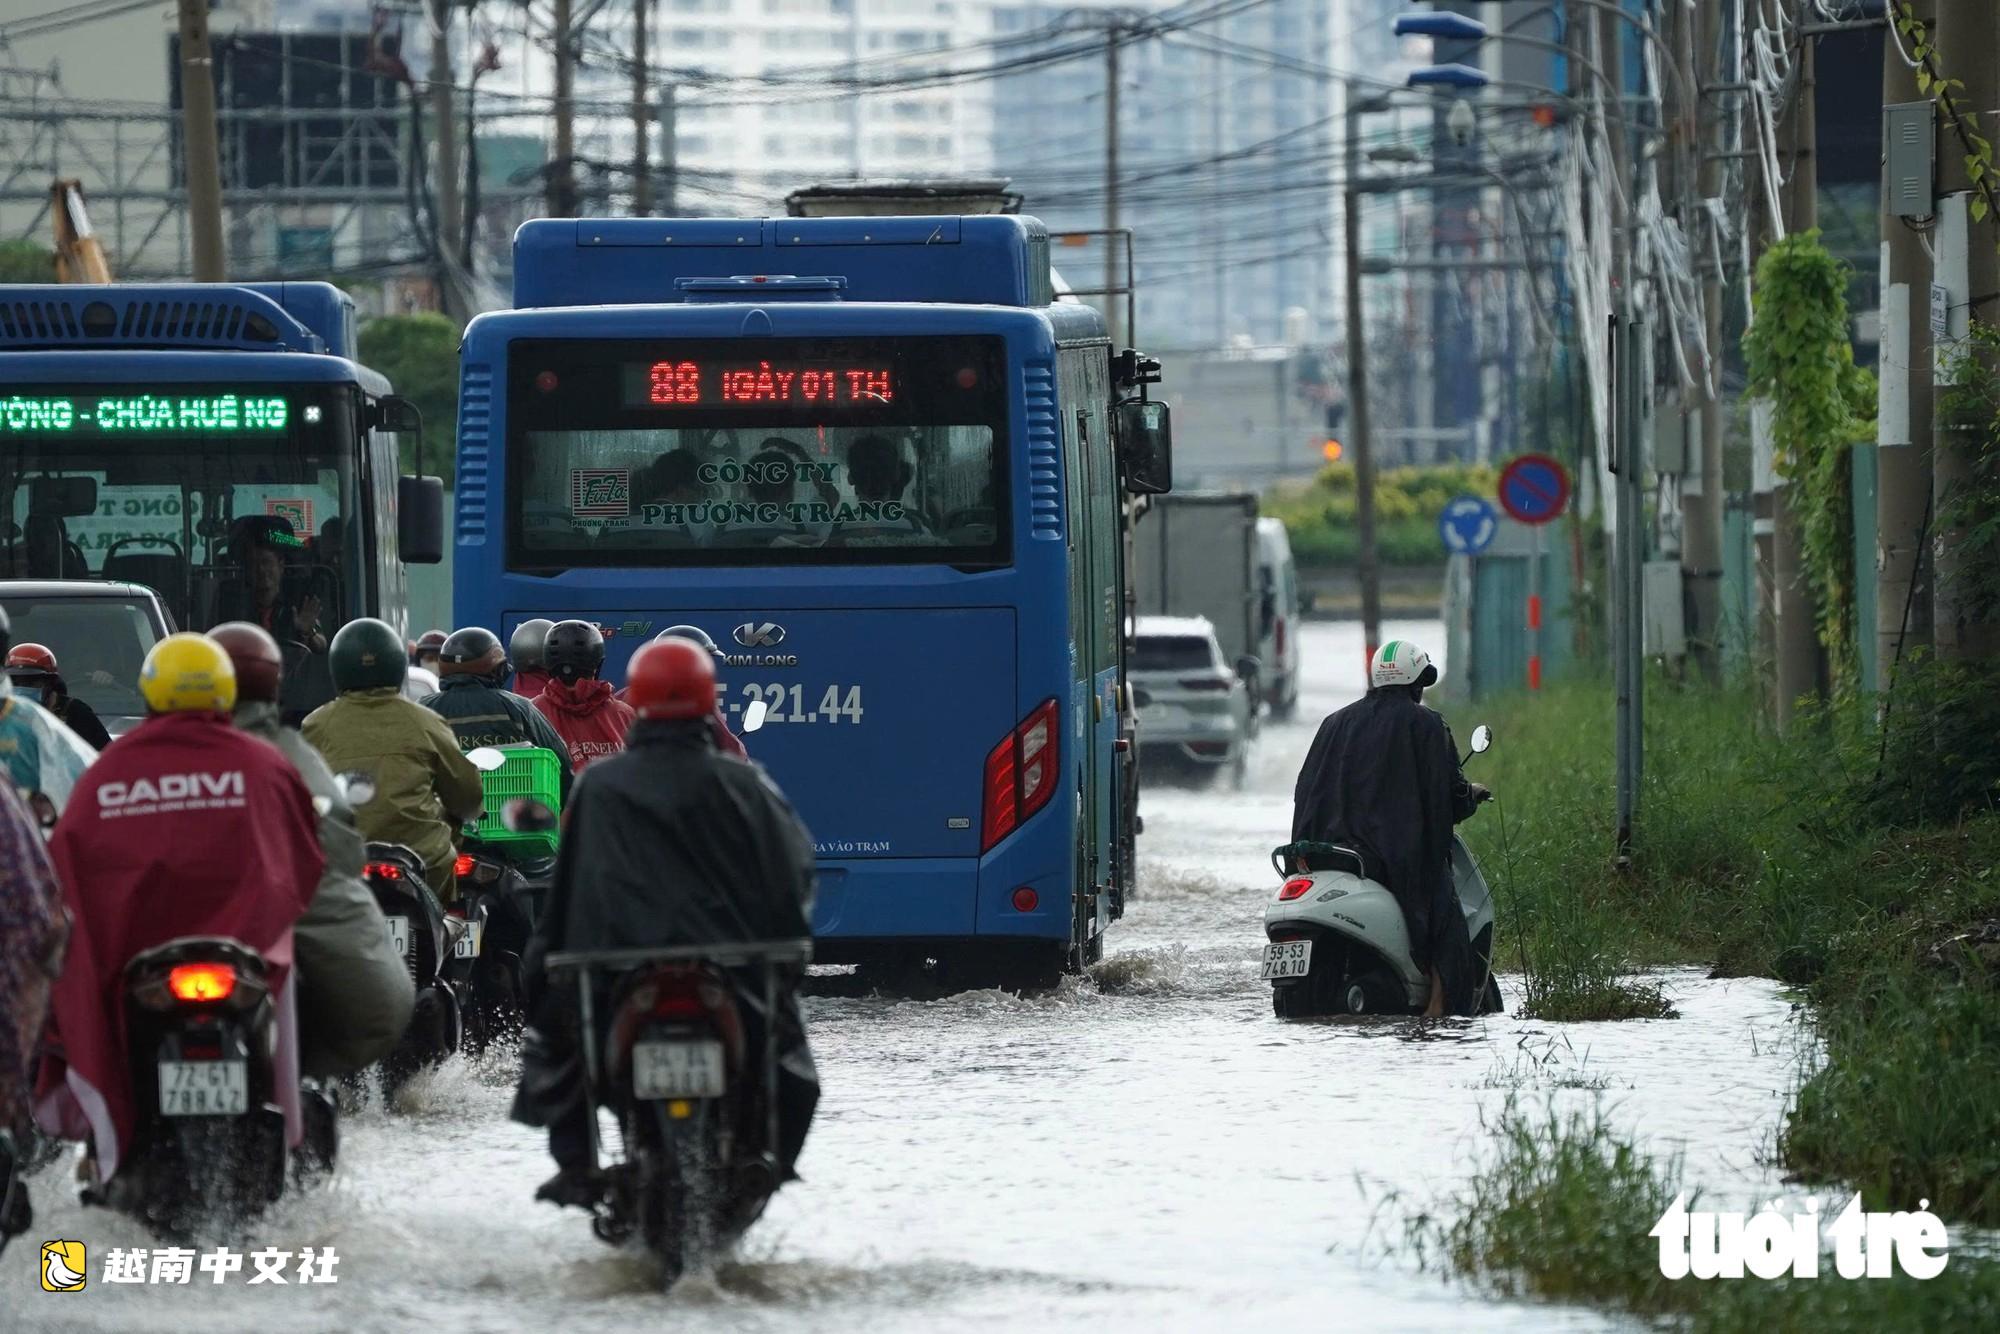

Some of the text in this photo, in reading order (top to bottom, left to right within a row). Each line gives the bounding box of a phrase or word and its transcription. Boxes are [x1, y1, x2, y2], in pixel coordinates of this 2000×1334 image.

[651, 362, 699, 401] 88
[802, 371, 834, 399] 01
[180, 395, 238, 428] HUÊ
[245, 399, 288, 428] NG
[697, 457, 841, 484] CÔNG TY
[642, 500, 905, 525] PHƯƠNG TRANG
[723, 655, 797, 666] KIM LONG
[97, 771, 245, 807] CADIVI
[828, 840, 853, 852] VÀO
[855, 842, 890, 853] TRẠM
[1270, 944, 1304, 961] 59-S3
[1264, 959, 1305, 977] 748.10
